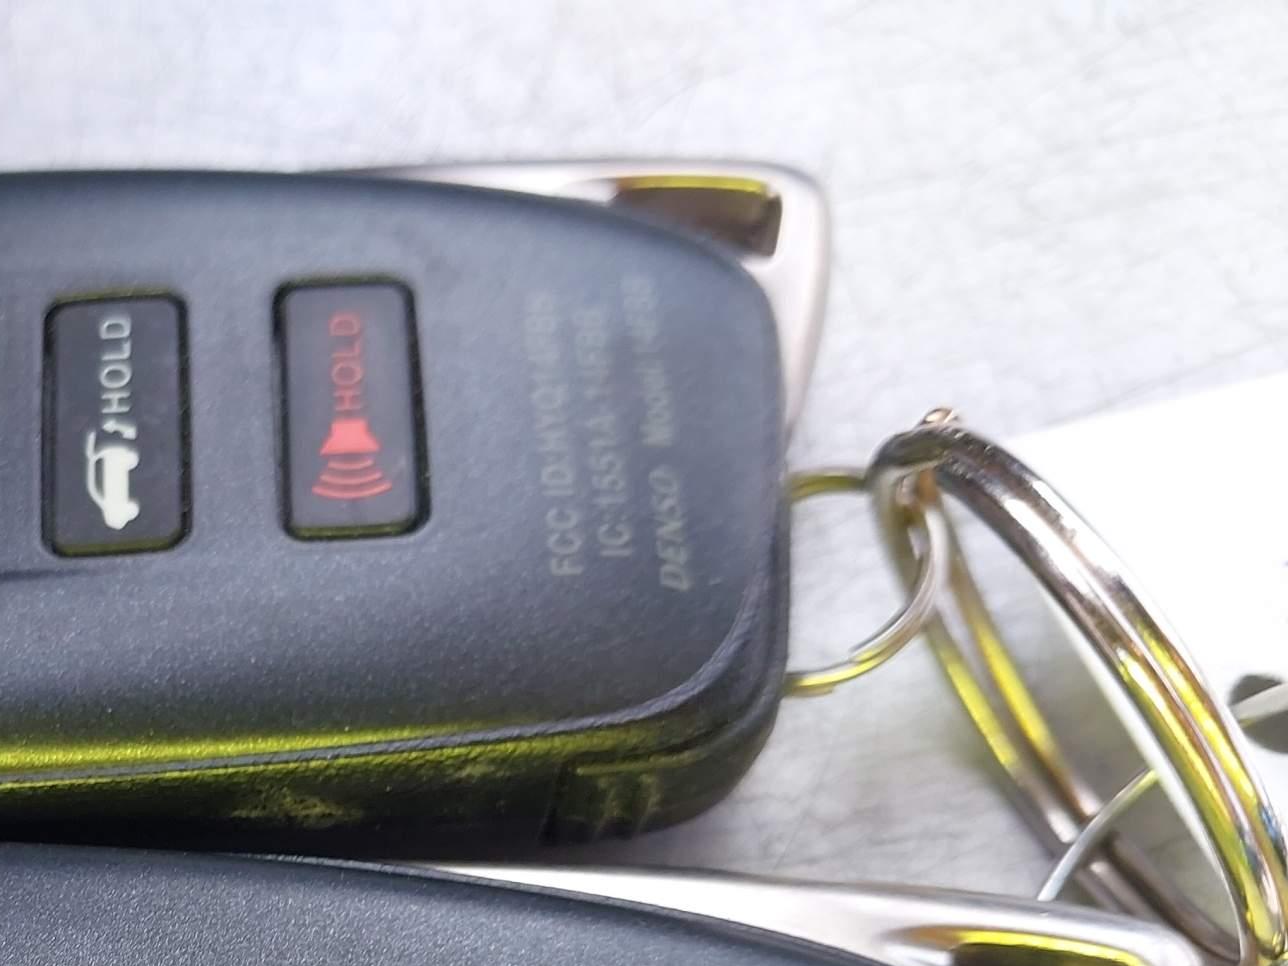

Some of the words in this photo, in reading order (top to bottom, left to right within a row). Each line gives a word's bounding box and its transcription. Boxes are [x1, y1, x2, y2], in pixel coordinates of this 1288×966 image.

[99, 315, 132, 415] HOLD
[328, 311, 364, 412] HOLD
[546, 507, 584, 577] FCC
[647, 466, 692, 592] DENSO
